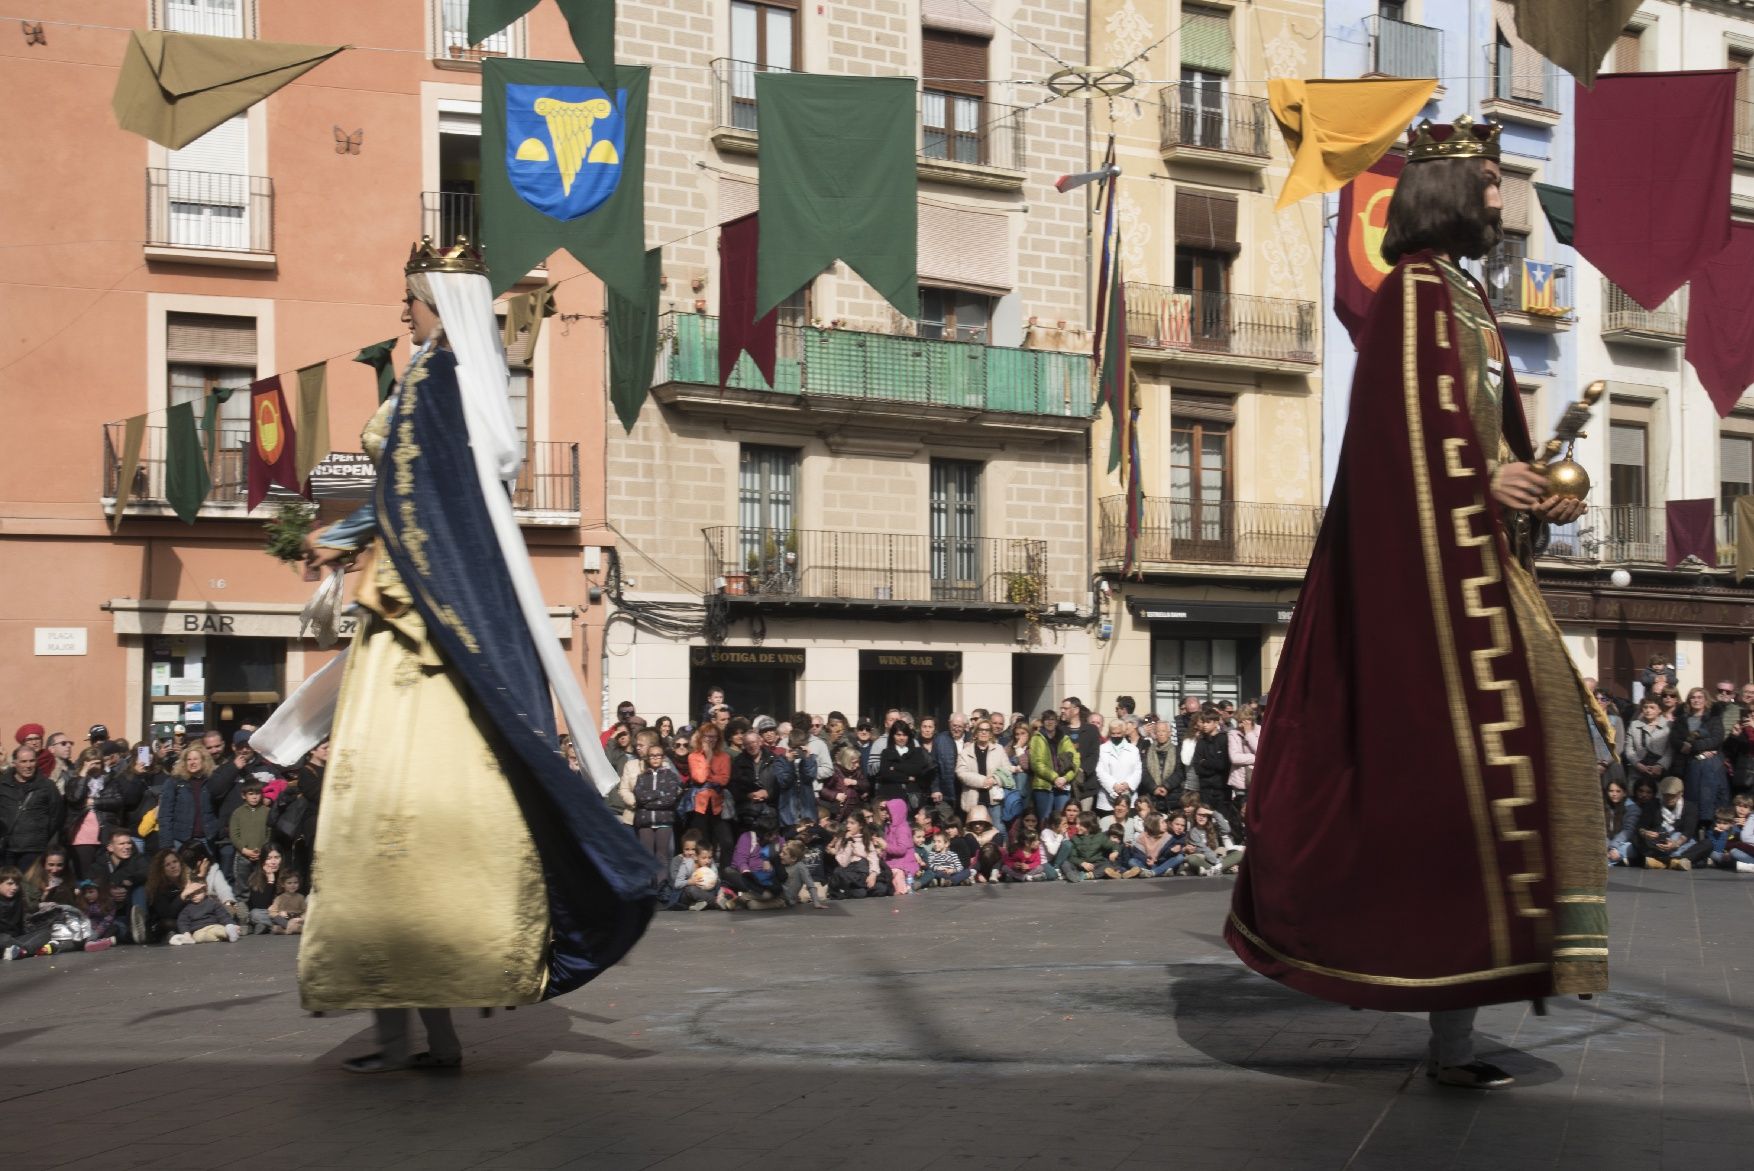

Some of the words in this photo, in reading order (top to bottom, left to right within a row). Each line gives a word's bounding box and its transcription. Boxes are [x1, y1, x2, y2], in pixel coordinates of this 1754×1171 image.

[332, 453, 354, 462] PER
[309, 464, 377, 476] NDEPEN
[184, 615, 235, 633] BAR
[711, 652, 757, 663] BOTIGA
[759, 653, 775, 663] DE
[777, 654, 805, 664] VINS
[878, 656, 907, 665] WINE
[910, 656, 934, 666] BAR
